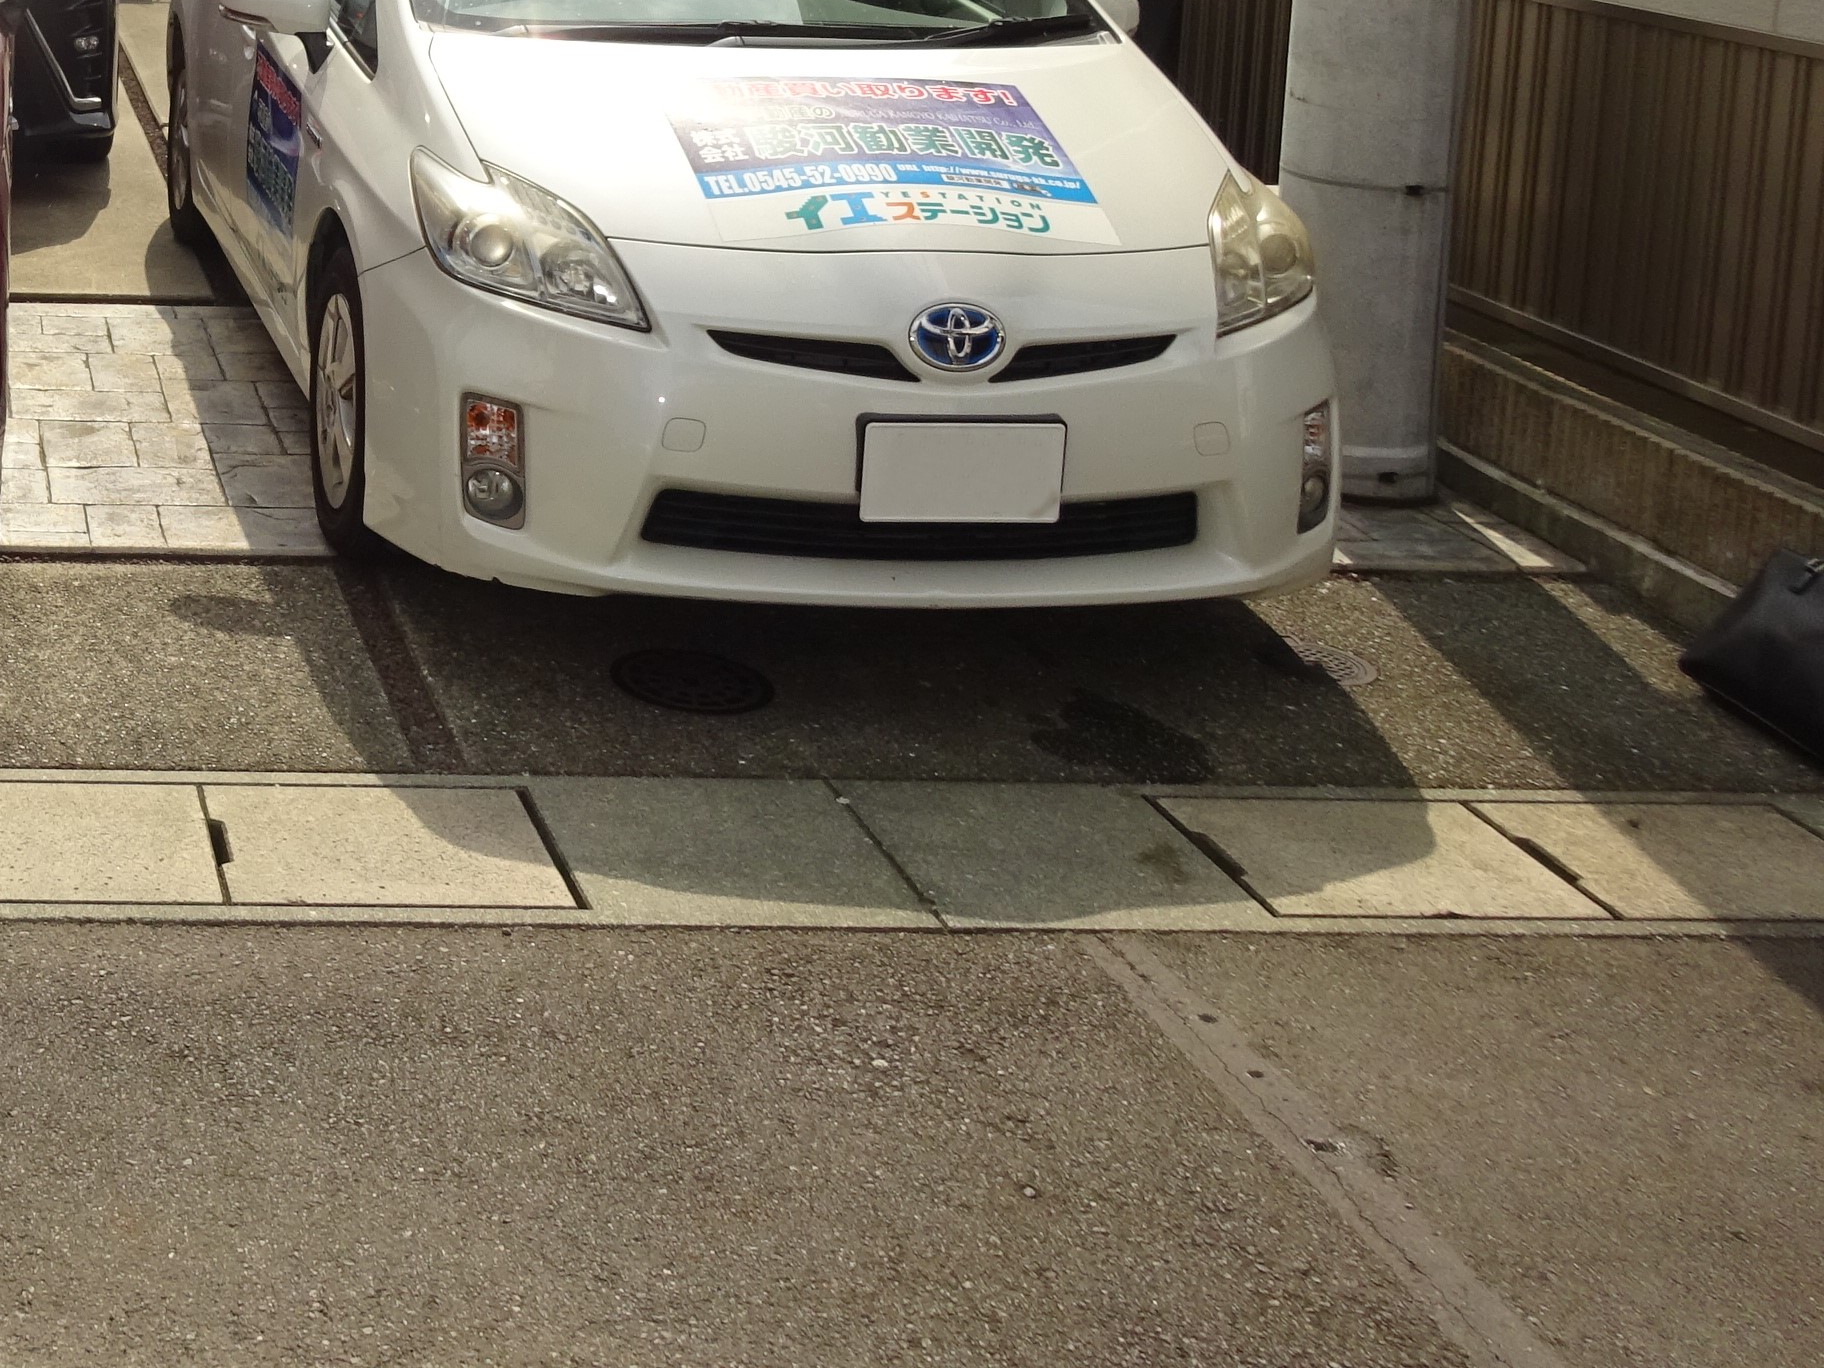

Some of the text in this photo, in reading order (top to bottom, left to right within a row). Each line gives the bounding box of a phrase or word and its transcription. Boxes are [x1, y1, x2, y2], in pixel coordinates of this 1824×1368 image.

[712, 81, 1017, 106] 動産買い取ります!
[744, 123, 1062, 169] 駿河勧業開発
